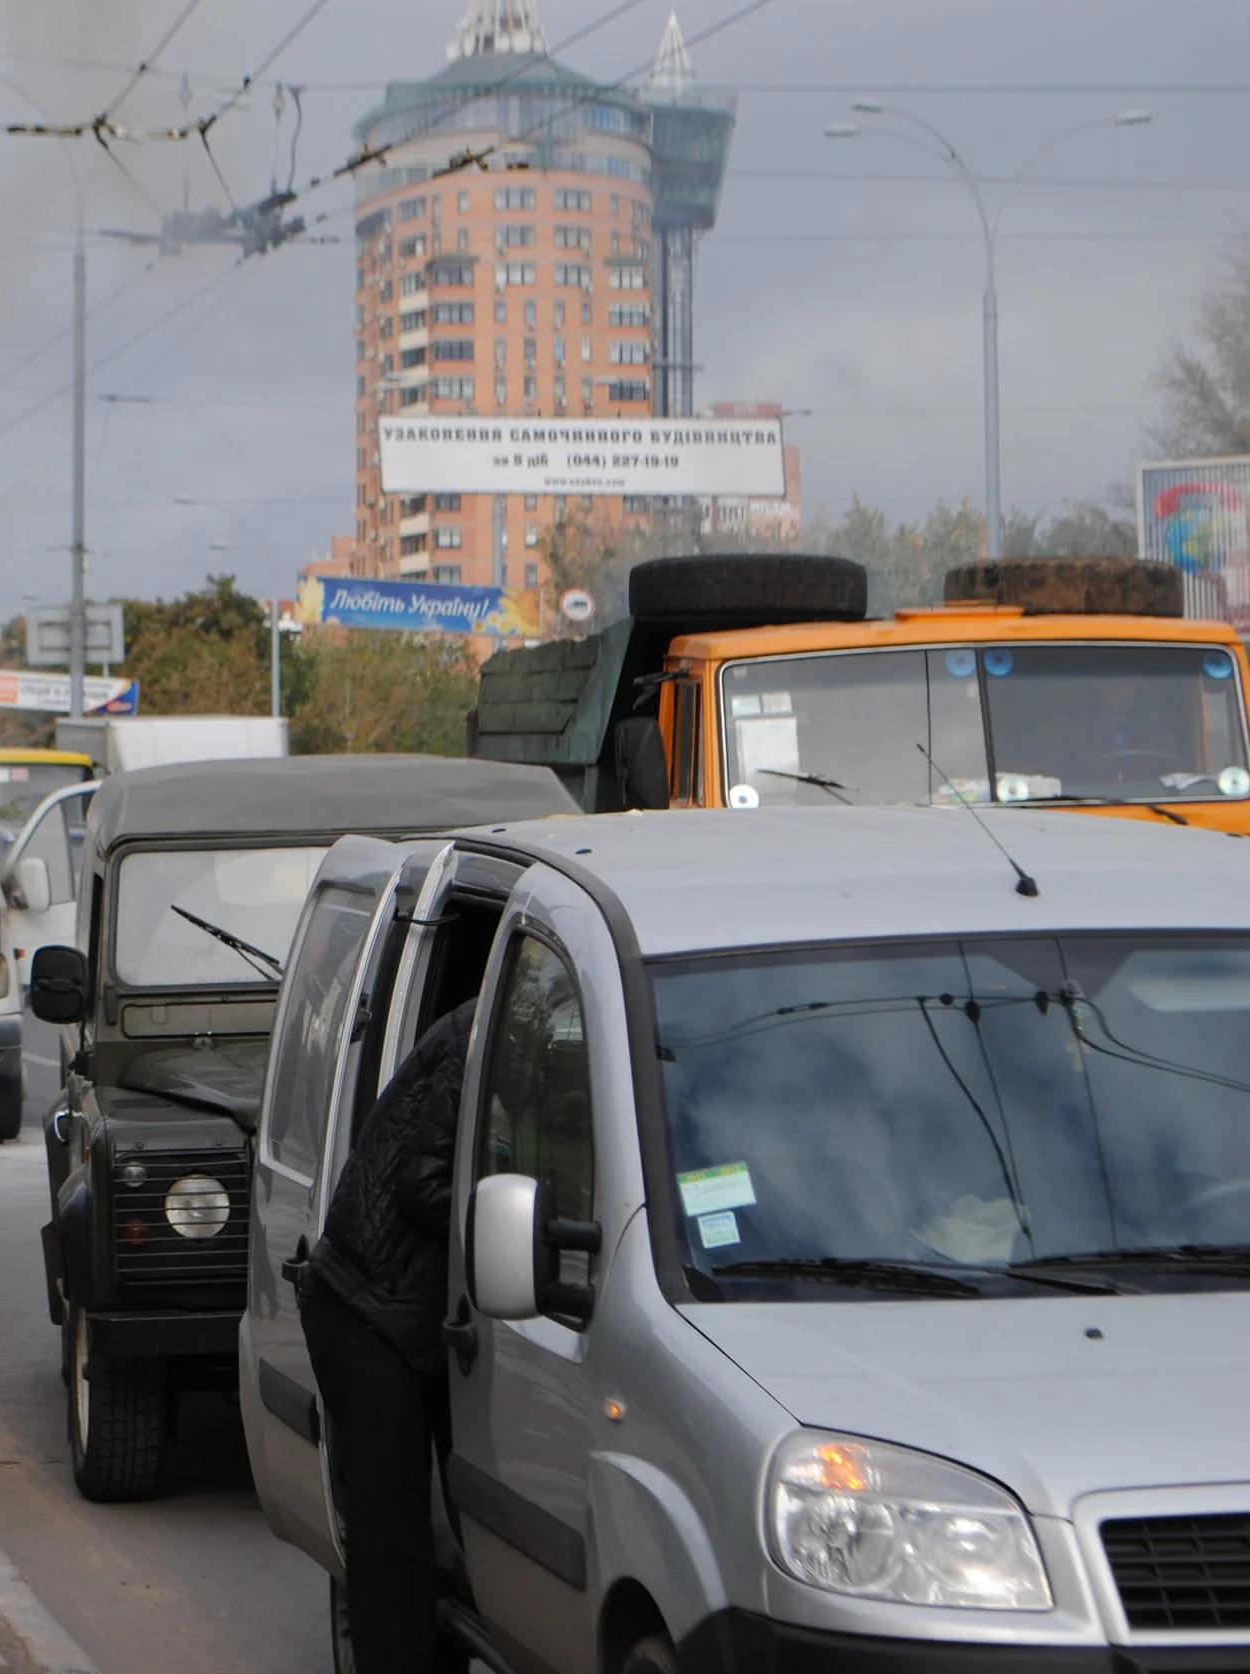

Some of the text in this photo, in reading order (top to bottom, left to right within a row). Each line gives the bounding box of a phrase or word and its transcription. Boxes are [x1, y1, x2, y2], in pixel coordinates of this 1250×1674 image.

[383, 426, 777, 447] УЗАКОНЕННЯ САМОЧИННОГО БУДІВНИЦТВА
[567, 453, 607, 470] (044)
[330, 588, 490, 622] Любіть Україну!
